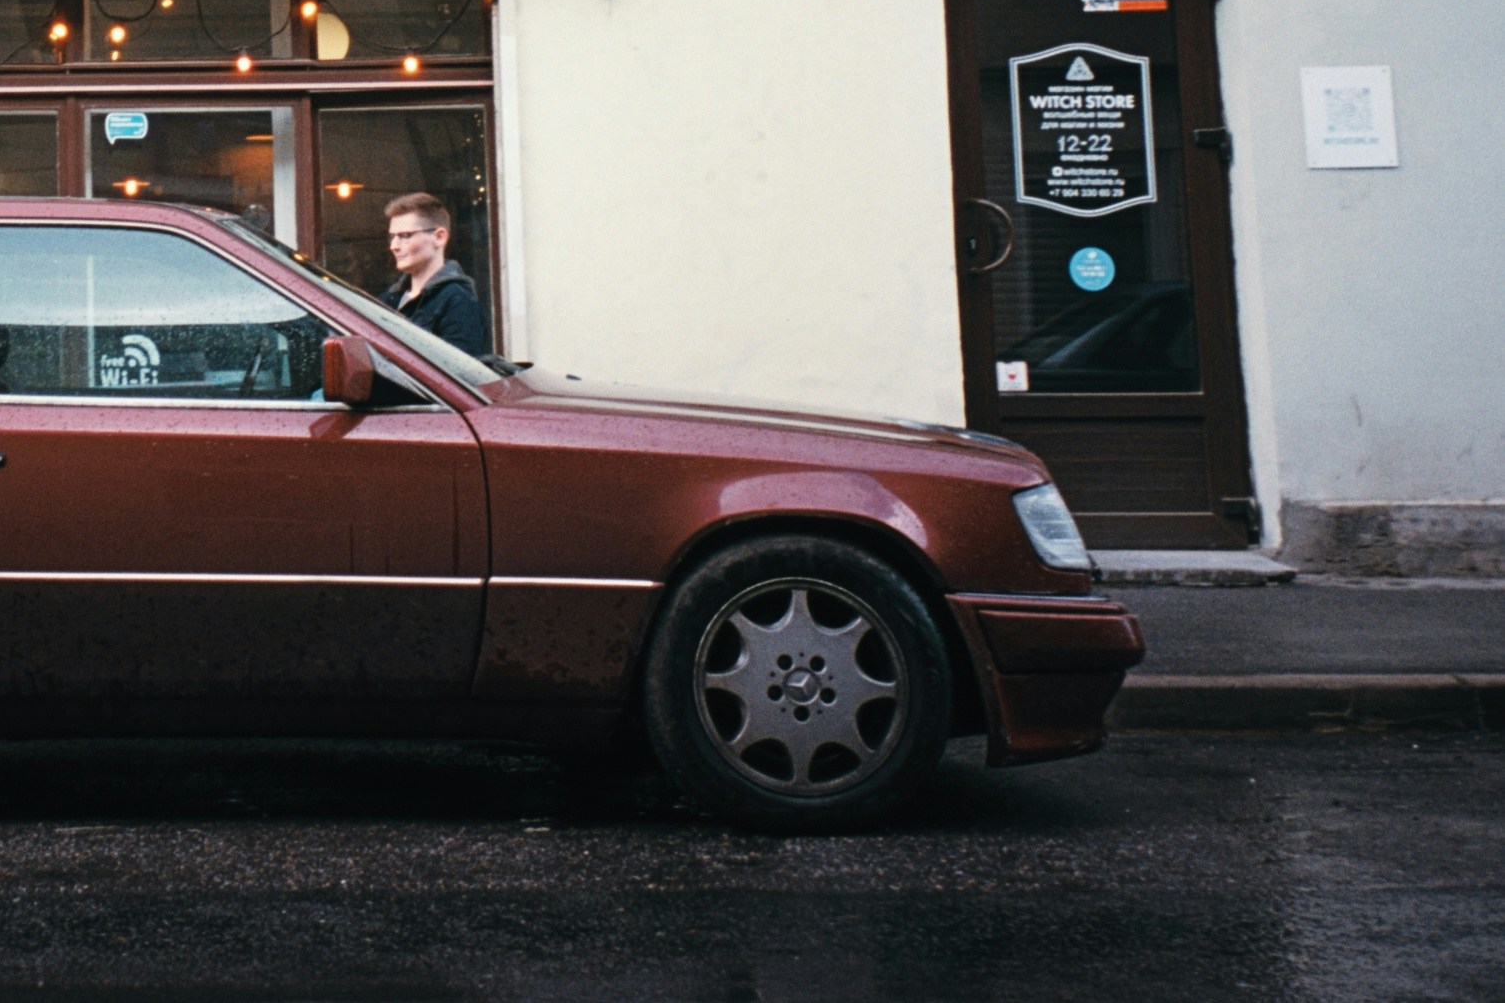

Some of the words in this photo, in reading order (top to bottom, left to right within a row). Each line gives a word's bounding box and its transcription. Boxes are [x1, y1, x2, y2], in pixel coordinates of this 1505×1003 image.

[1029, 95, 1082, 109] WITCH
[1085, 94, 1135, 108] STORE
[1058, 134, 1113, 152] 12-22
[100, 368, 158, 387] Wi-Fi
